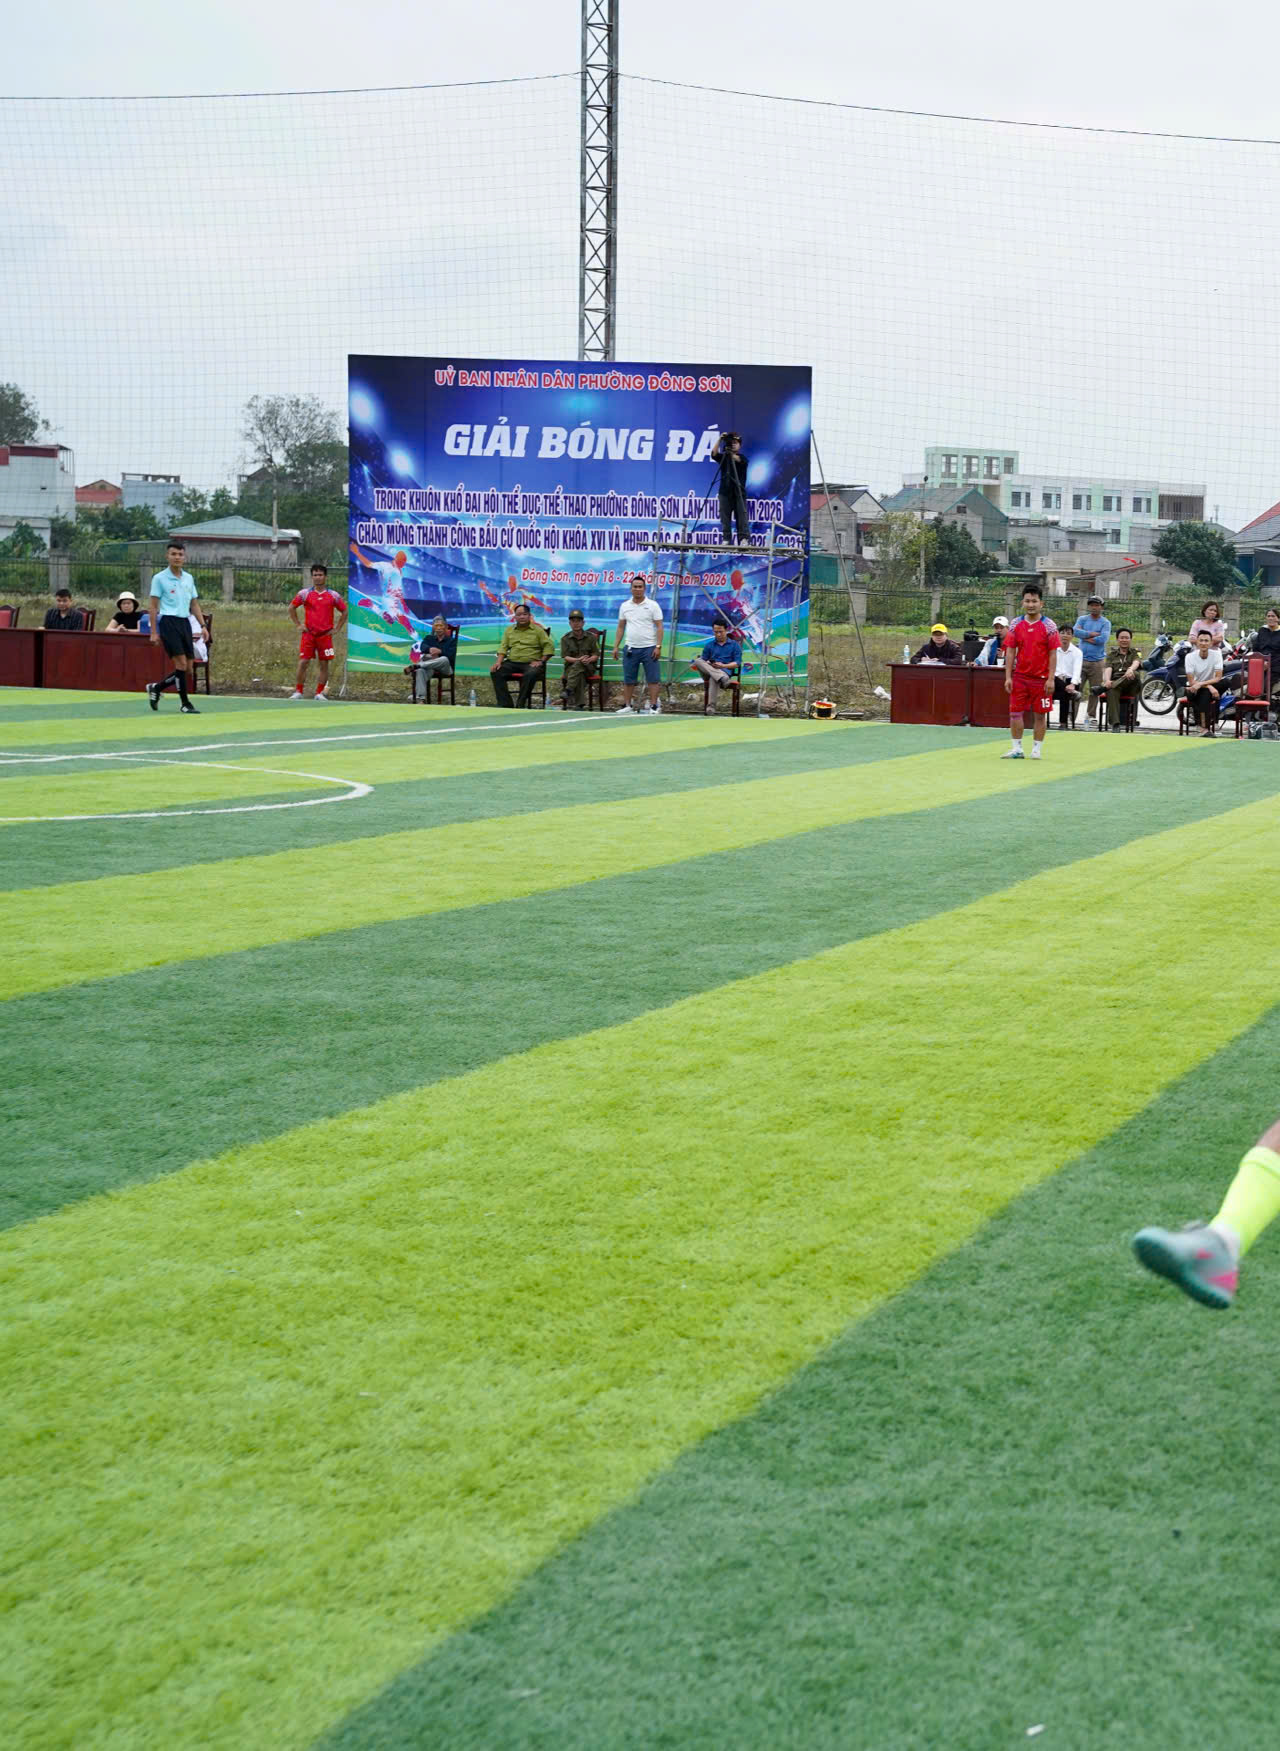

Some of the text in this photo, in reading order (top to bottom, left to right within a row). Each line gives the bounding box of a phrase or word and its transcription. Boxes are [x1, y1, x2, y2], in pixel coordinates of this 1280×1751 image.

[435, 365, 732, 393] UỶ BAN NHÂN DÂN PHƯỜNG ĐÔNG SƠN
[444, 416, 721, 462] GIẢI BÓNG ĐÁ
[375, 488, 406, 511] TRONG
[408, 485, 441, 513] KHUÔN
[443, 483, 464, 513] KHỔ
[465, 491, 481, 518] ĐẠI
[483, 488, 500, 518] HỘI
[501, 485, 521, 515] THỂ
[522, 493, 541, 520] DỤC
[543, 485, 563, 516] THỂ
[563, 493, 587, 516] THAO
[589, 491, 629, 517] PHƯỜNG
[631, 491, 657, 518] ĐÔNG
[660, 495, 681, 519] SƠN
[682, 490, 702, 520] LẦN
[758, 499, 784, 523] 2026
[357, 518, 385, 545] CHÀO
[386, 519, 415, 546] MỪNG
[416, 521, 449, 547] THÀNH
[450, 521, 477, 548] CÔNG
[479, 519, 498, 548] BẦU
[500, 521, 515, 549] CỬ
[516, 519, 542, 551] QUỐC
[543, 525, 560, 554] HỘI
[562, 524, 588, 551] KHÓA
[590, 531, 607, 552] XVI
[608, 525, 621, 552] VÀ
[623, 531, 650, 553] HĐND
[521, 568, 548, 585] Đông
[550, 569, 572, 585] Sơn,
[574, 571, 600, 586] ngày
[603, 571, 615, 583] 18
[622, 571, 635, 584] 22
[668, 573, 676, 585] 3
[702, 572, 727, 586] 2026
[1041, 698, 1051, 709] 15
